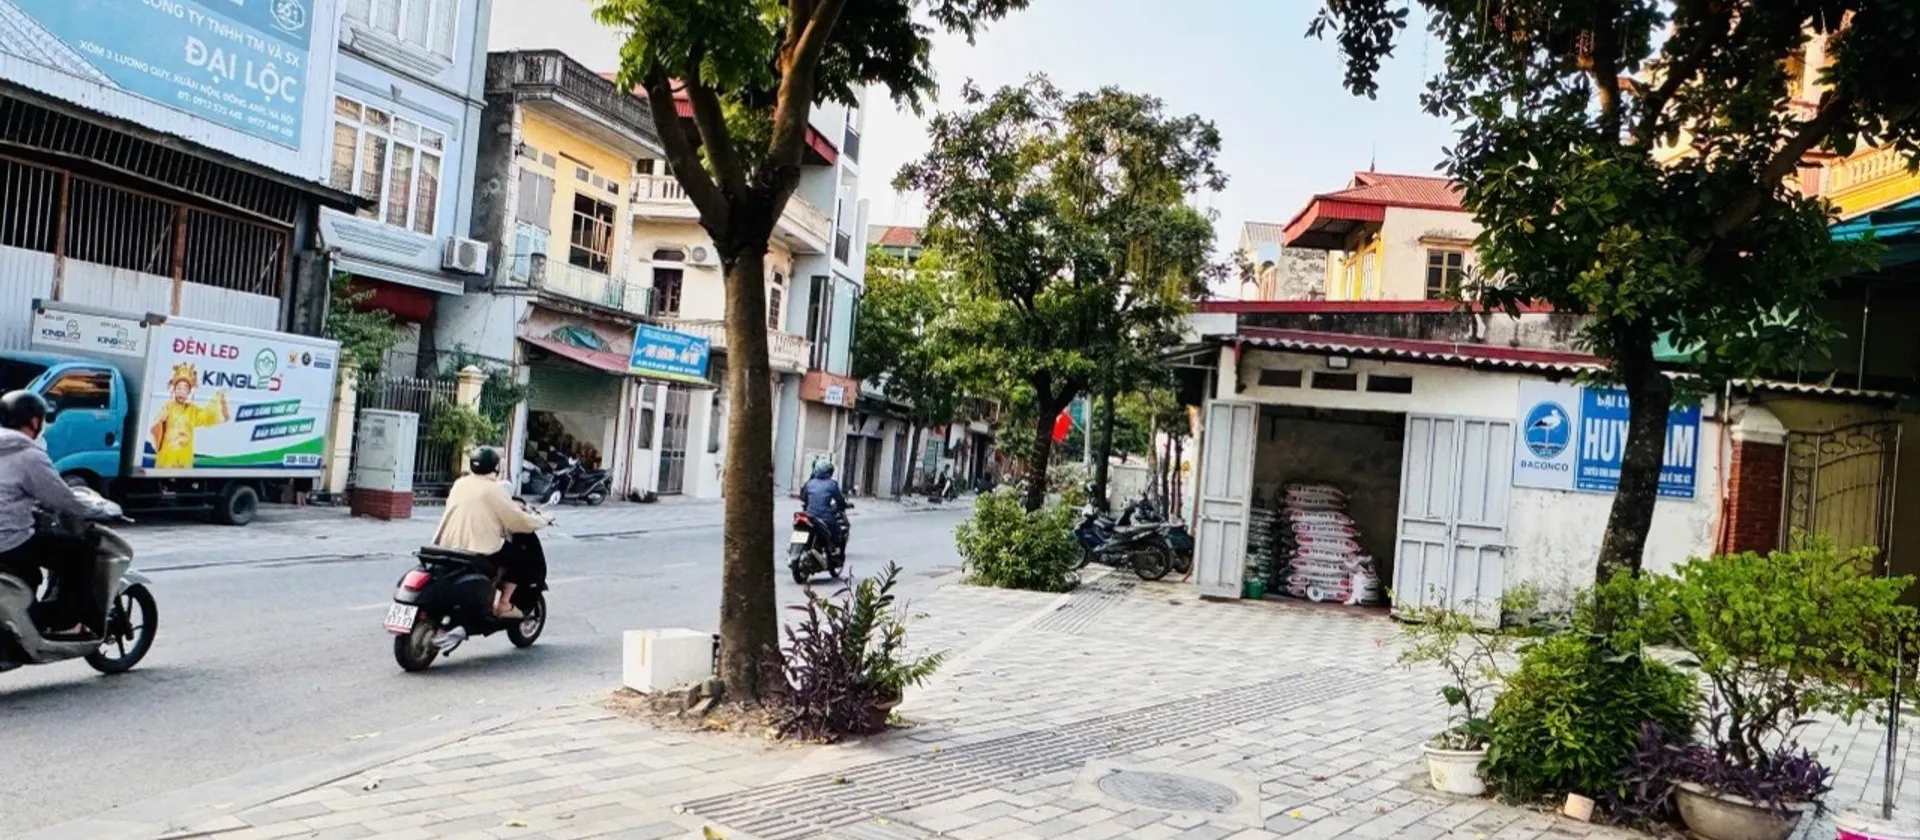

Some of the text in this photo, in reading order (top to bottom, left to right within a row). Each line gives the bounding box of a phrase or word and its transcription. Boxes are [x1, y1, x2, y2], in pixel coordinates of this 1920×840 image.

[187, 9, 205, 27] TY
[208, 17, 244, 44] TNHH
[245, 33, 265, 53] TM
[267, 43, 282, 61] VÀ
[284, 51, 300, 68] SX
[184, 35, 298, 103] ĐẠI LỘC
[172, 336, 240, 360] ĐÈN LED
[202, 369, 283, 392] KINGLED
[1584, 417, 1630, 462] HUY
[1519, 460, 1569, 472] BACONCO
